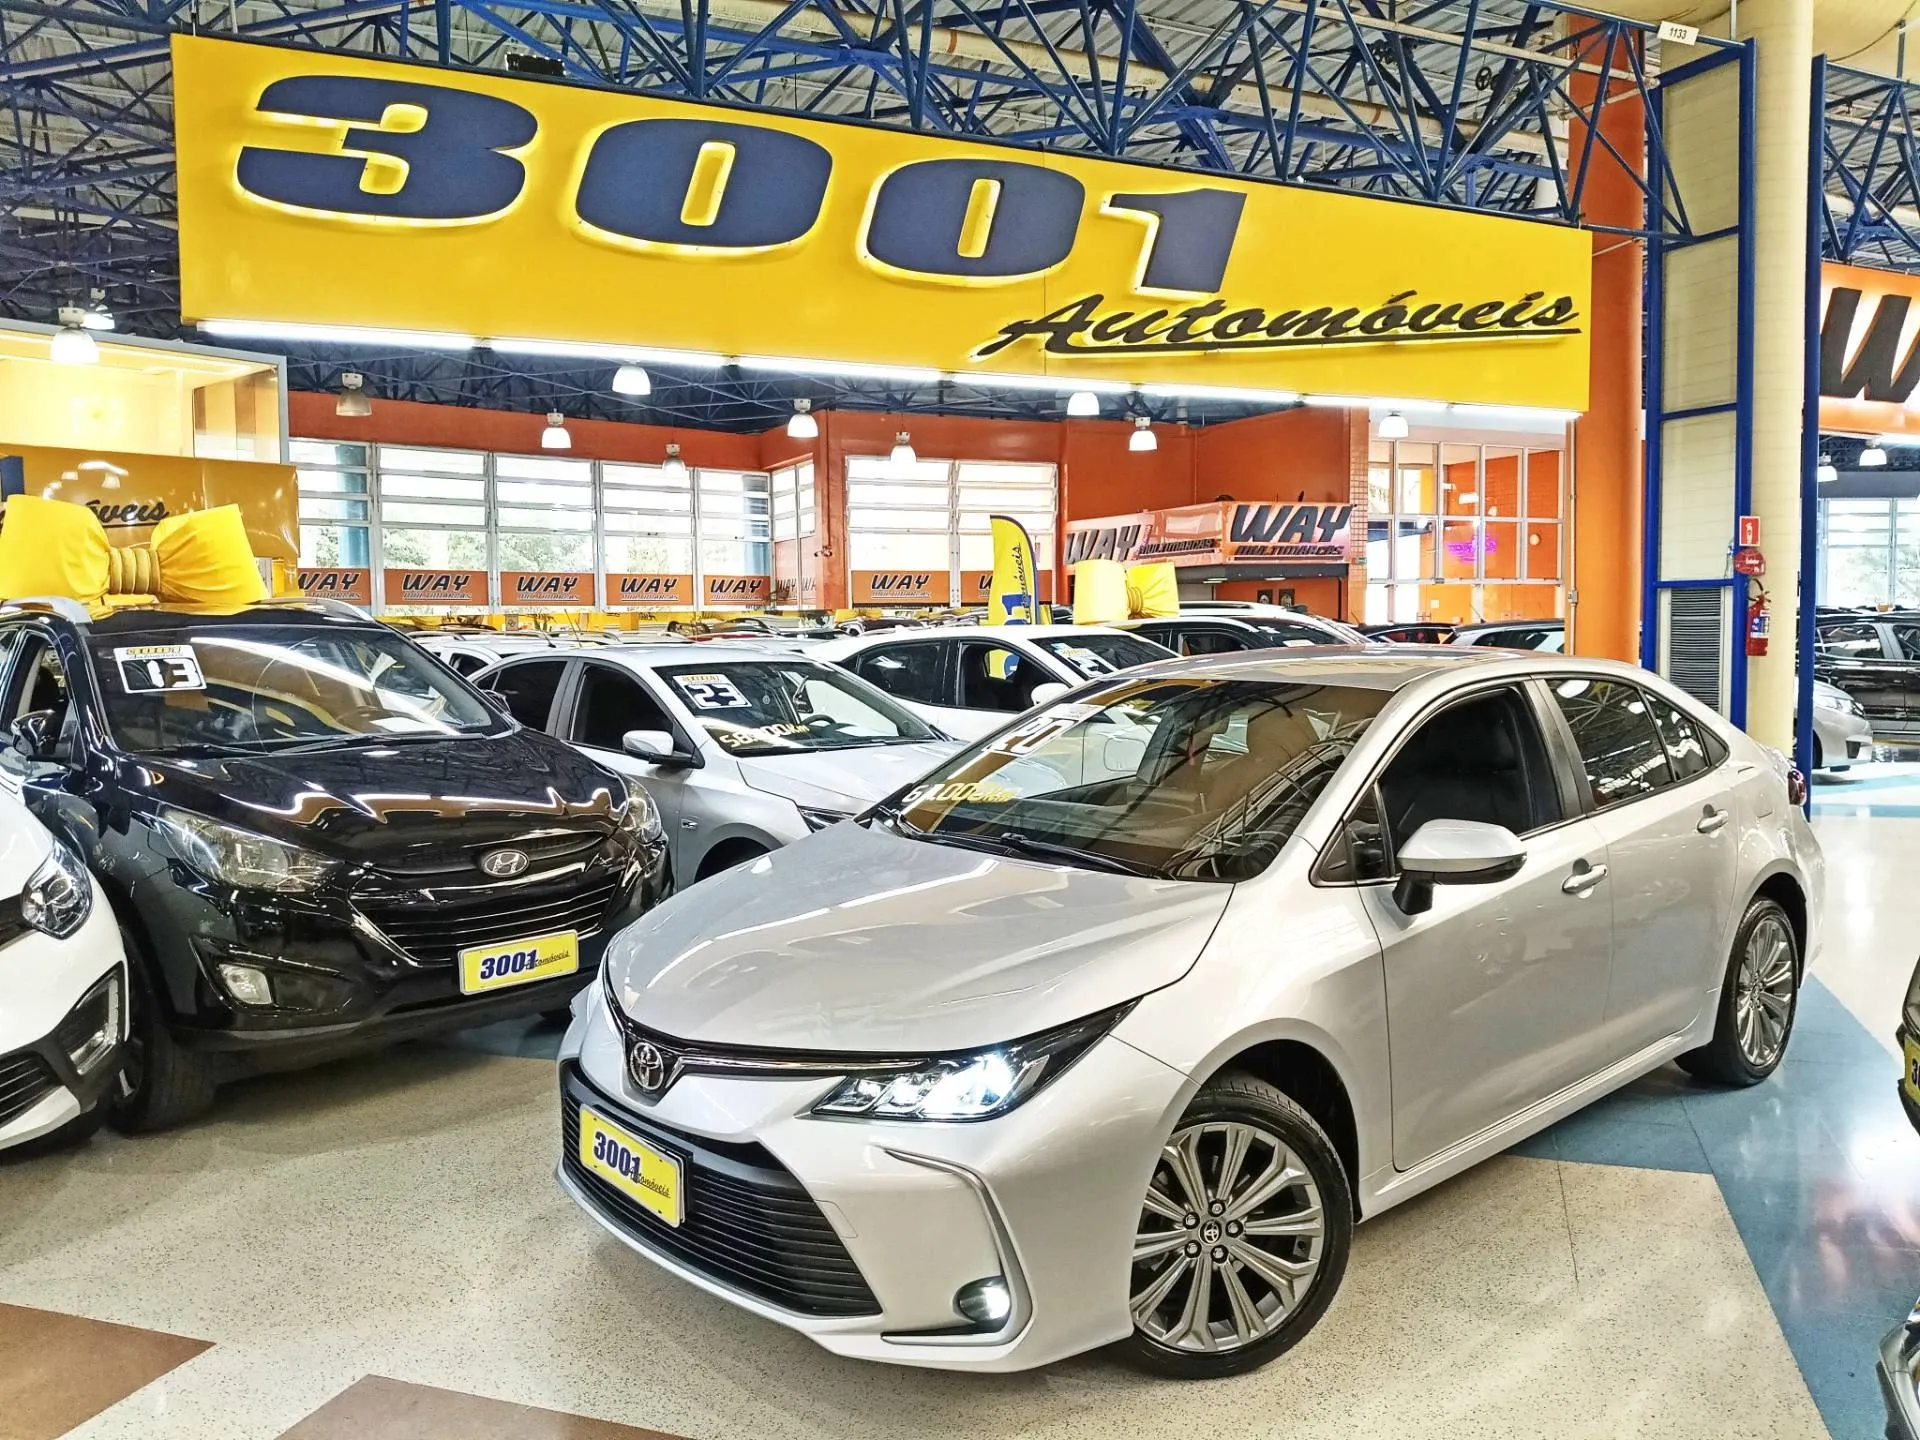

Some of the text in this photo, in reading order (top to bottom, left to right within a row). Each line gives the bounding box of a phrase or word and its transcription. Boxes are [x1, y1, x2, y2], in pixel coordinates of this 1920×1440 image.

[1669, 27, 1688, 40] 1133
[237, 75, 1248, 294] 3001
[976, 289, 1581, 353] Automóveis
[1230, 505, 1353, 543] WAY
[1065, 524, 1142, 564] WAY
[1234, 545, 1345, 556] MULTIMARCAS
[402, 574, 471, 591] WAY
[517, 576, 578, 592] WAY
[620, 578, 678, 592] WAY
[710, 579, 762, 592] WAY
[871, 574, 930, 590] WAY
[146, 658, 202, 688] 13
[687, 684, 746, 707] 23
[480, 949, 537, 979] 3001
[593, 1130, 641, 1184] 3001
